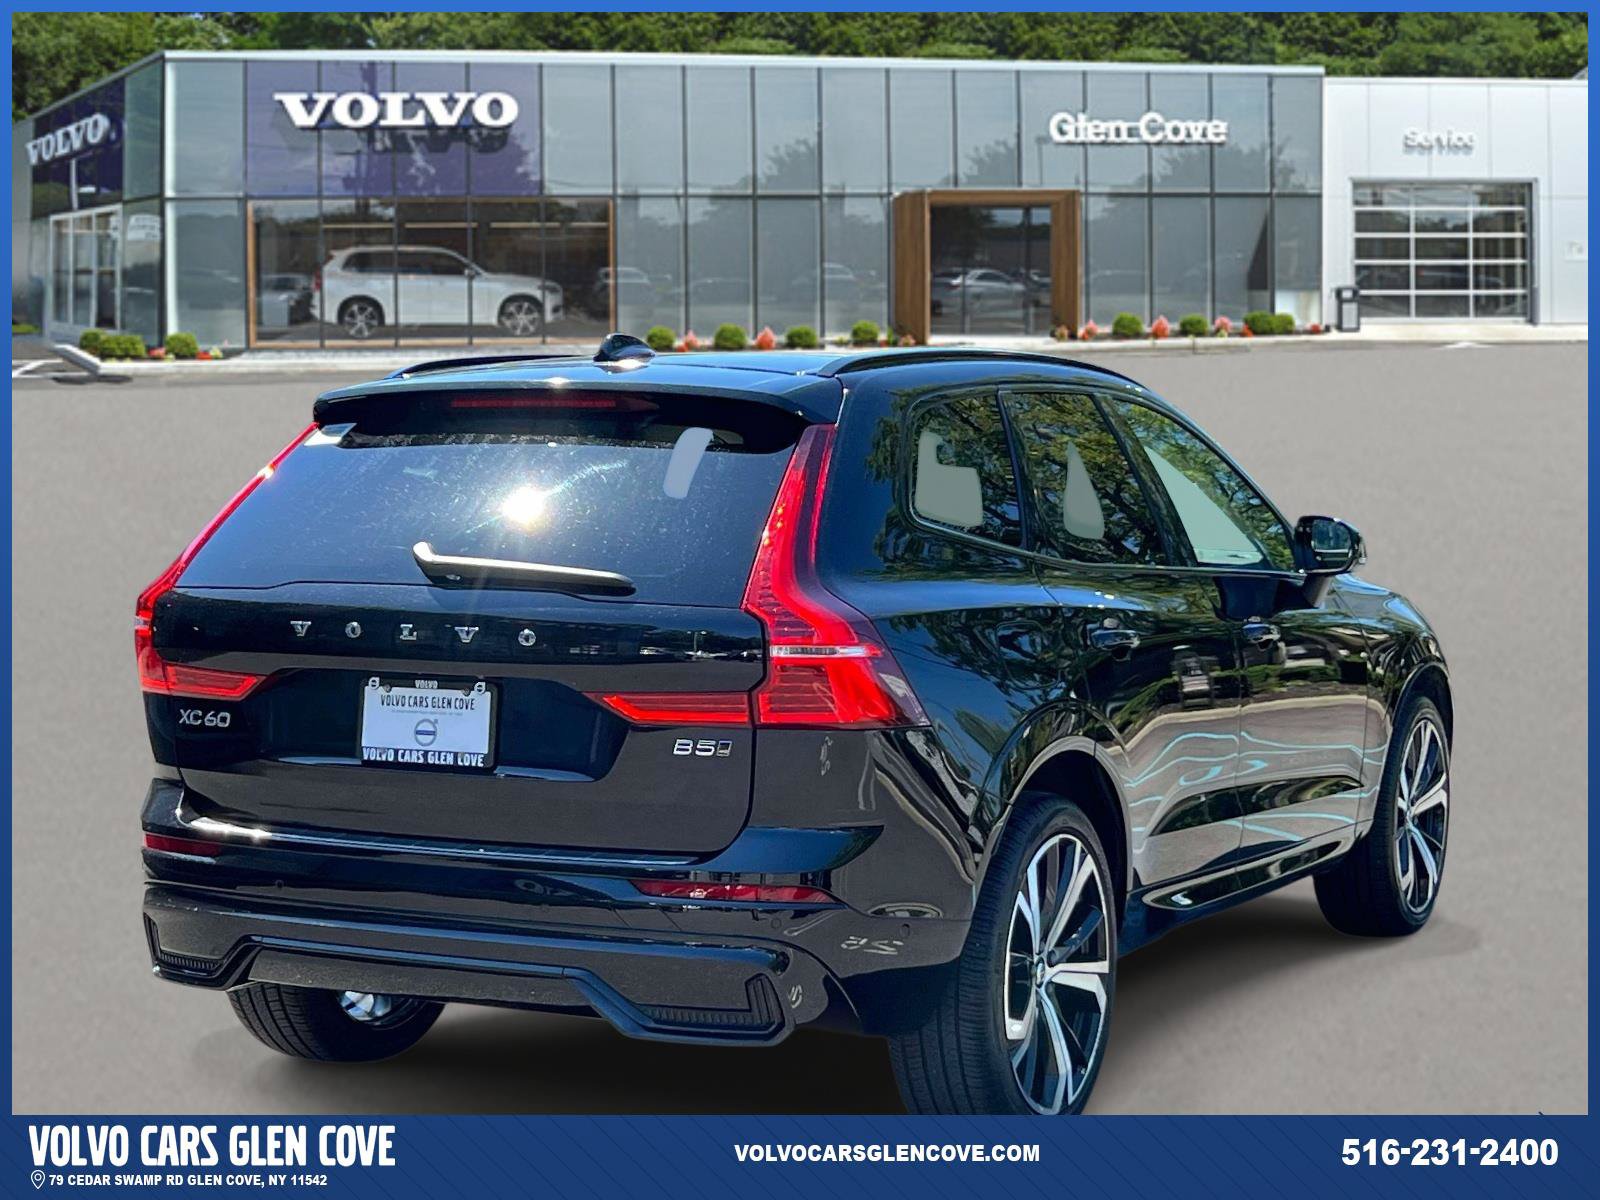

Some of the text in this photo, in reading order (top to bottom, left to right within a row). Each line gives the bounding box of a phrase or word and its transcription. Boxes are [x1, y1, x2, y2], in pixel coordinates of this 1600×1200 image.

[273, 92, 519, 128] VOLVO
[25, 113, 110, 165] VOLVO
[1050, 112, 1227, 144] Glen Cove
[1402, 127, 1477, 155] Service
[290, 620, 537, 646] VOLVO
[415, 679, 438, 689] VOLVO
[380, 694, 475, 710] VOLVO CARS GLEN COVE
[179, 709, 231, 727] XC60
[362, 747, 394, 761] VOLVO
[398, 750, 425, 764] CARS
[427, 751, 454, 765] GLEN
